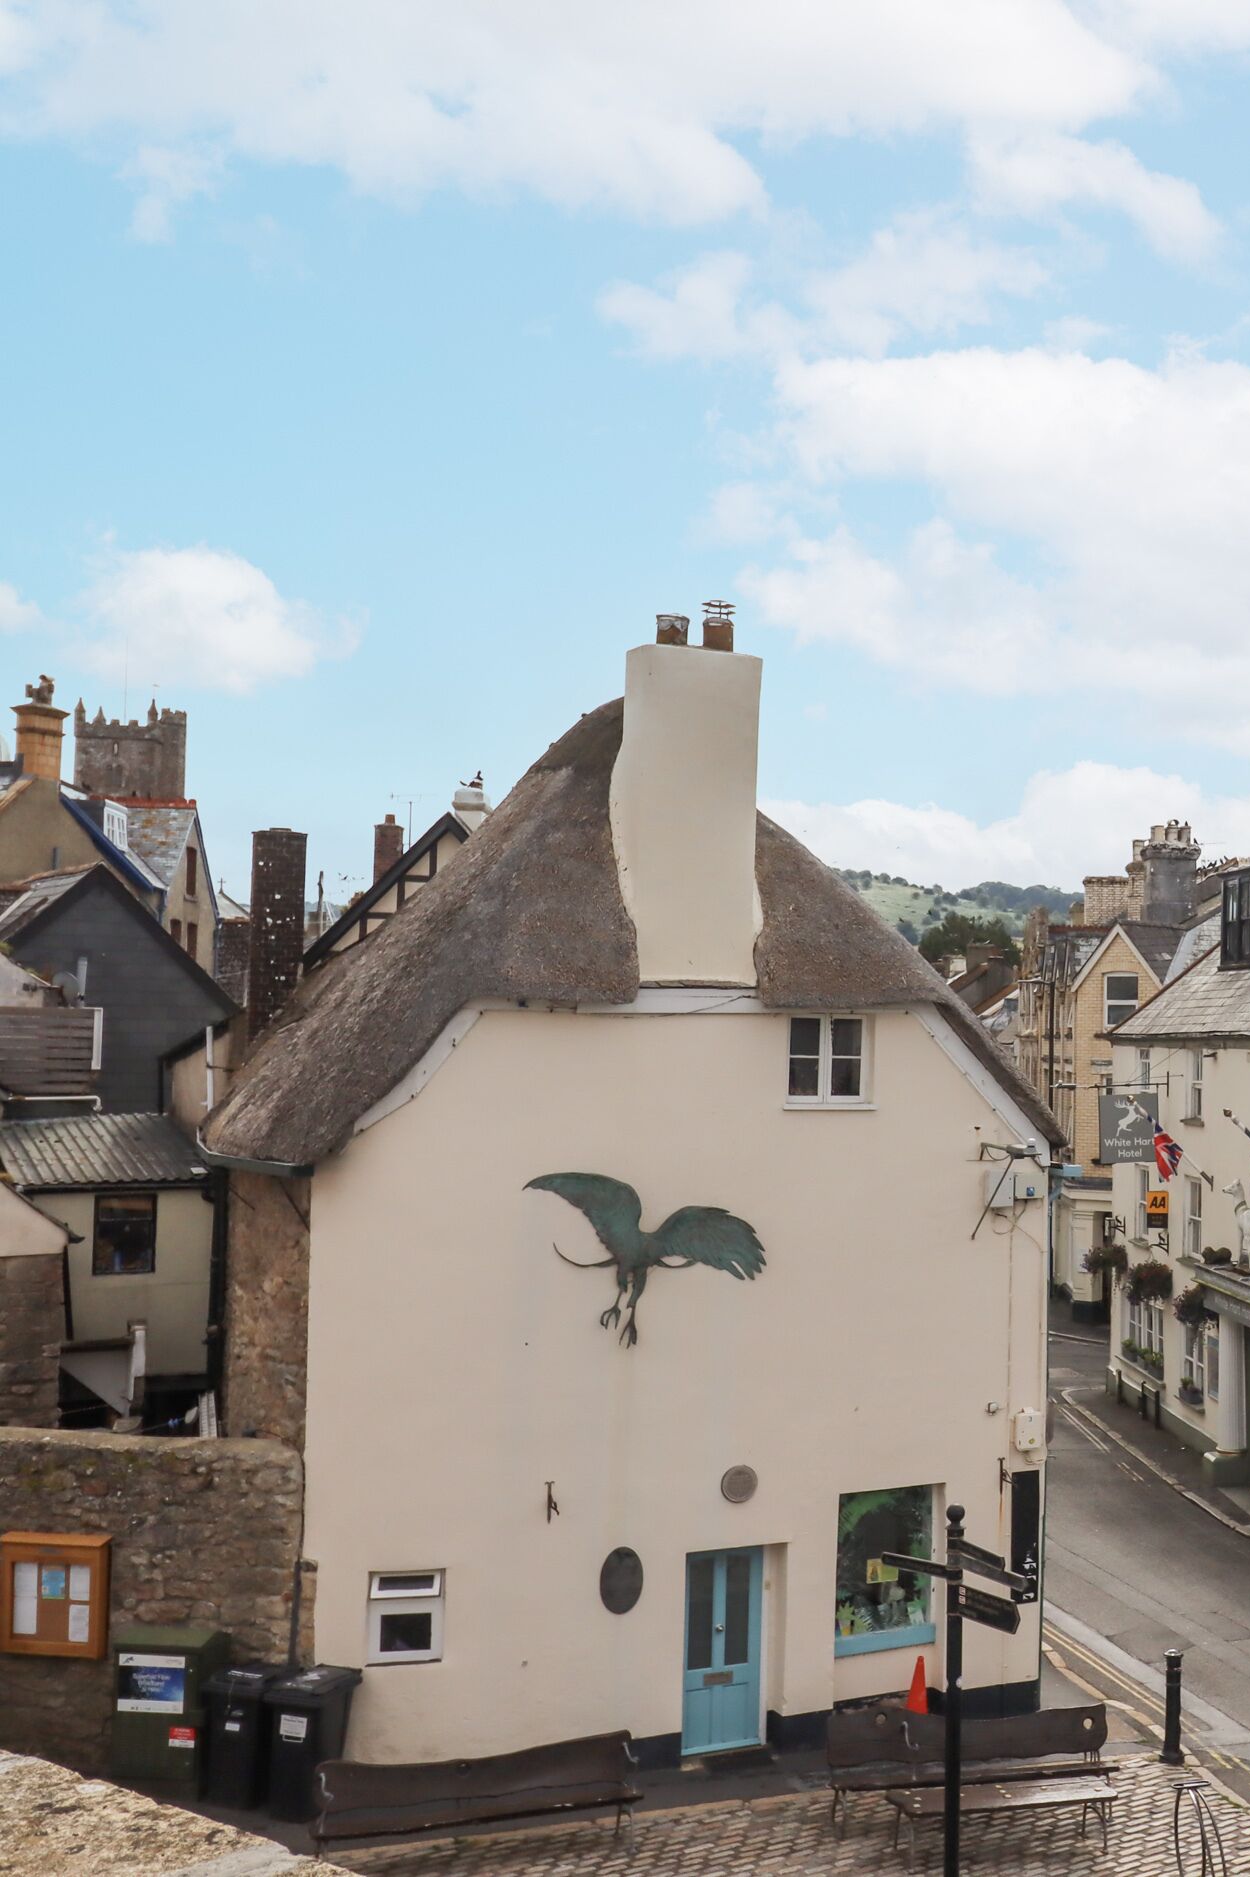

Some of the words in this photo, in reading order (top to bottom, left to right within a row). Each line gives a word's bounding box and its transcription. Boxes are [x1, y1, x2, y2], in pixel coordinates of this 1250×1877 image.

[1104, 1138, 1131, 1147] White
[1118, 1149, 1143, 1158] Hotel
[1150, 1196, 1166, 1209] AA
